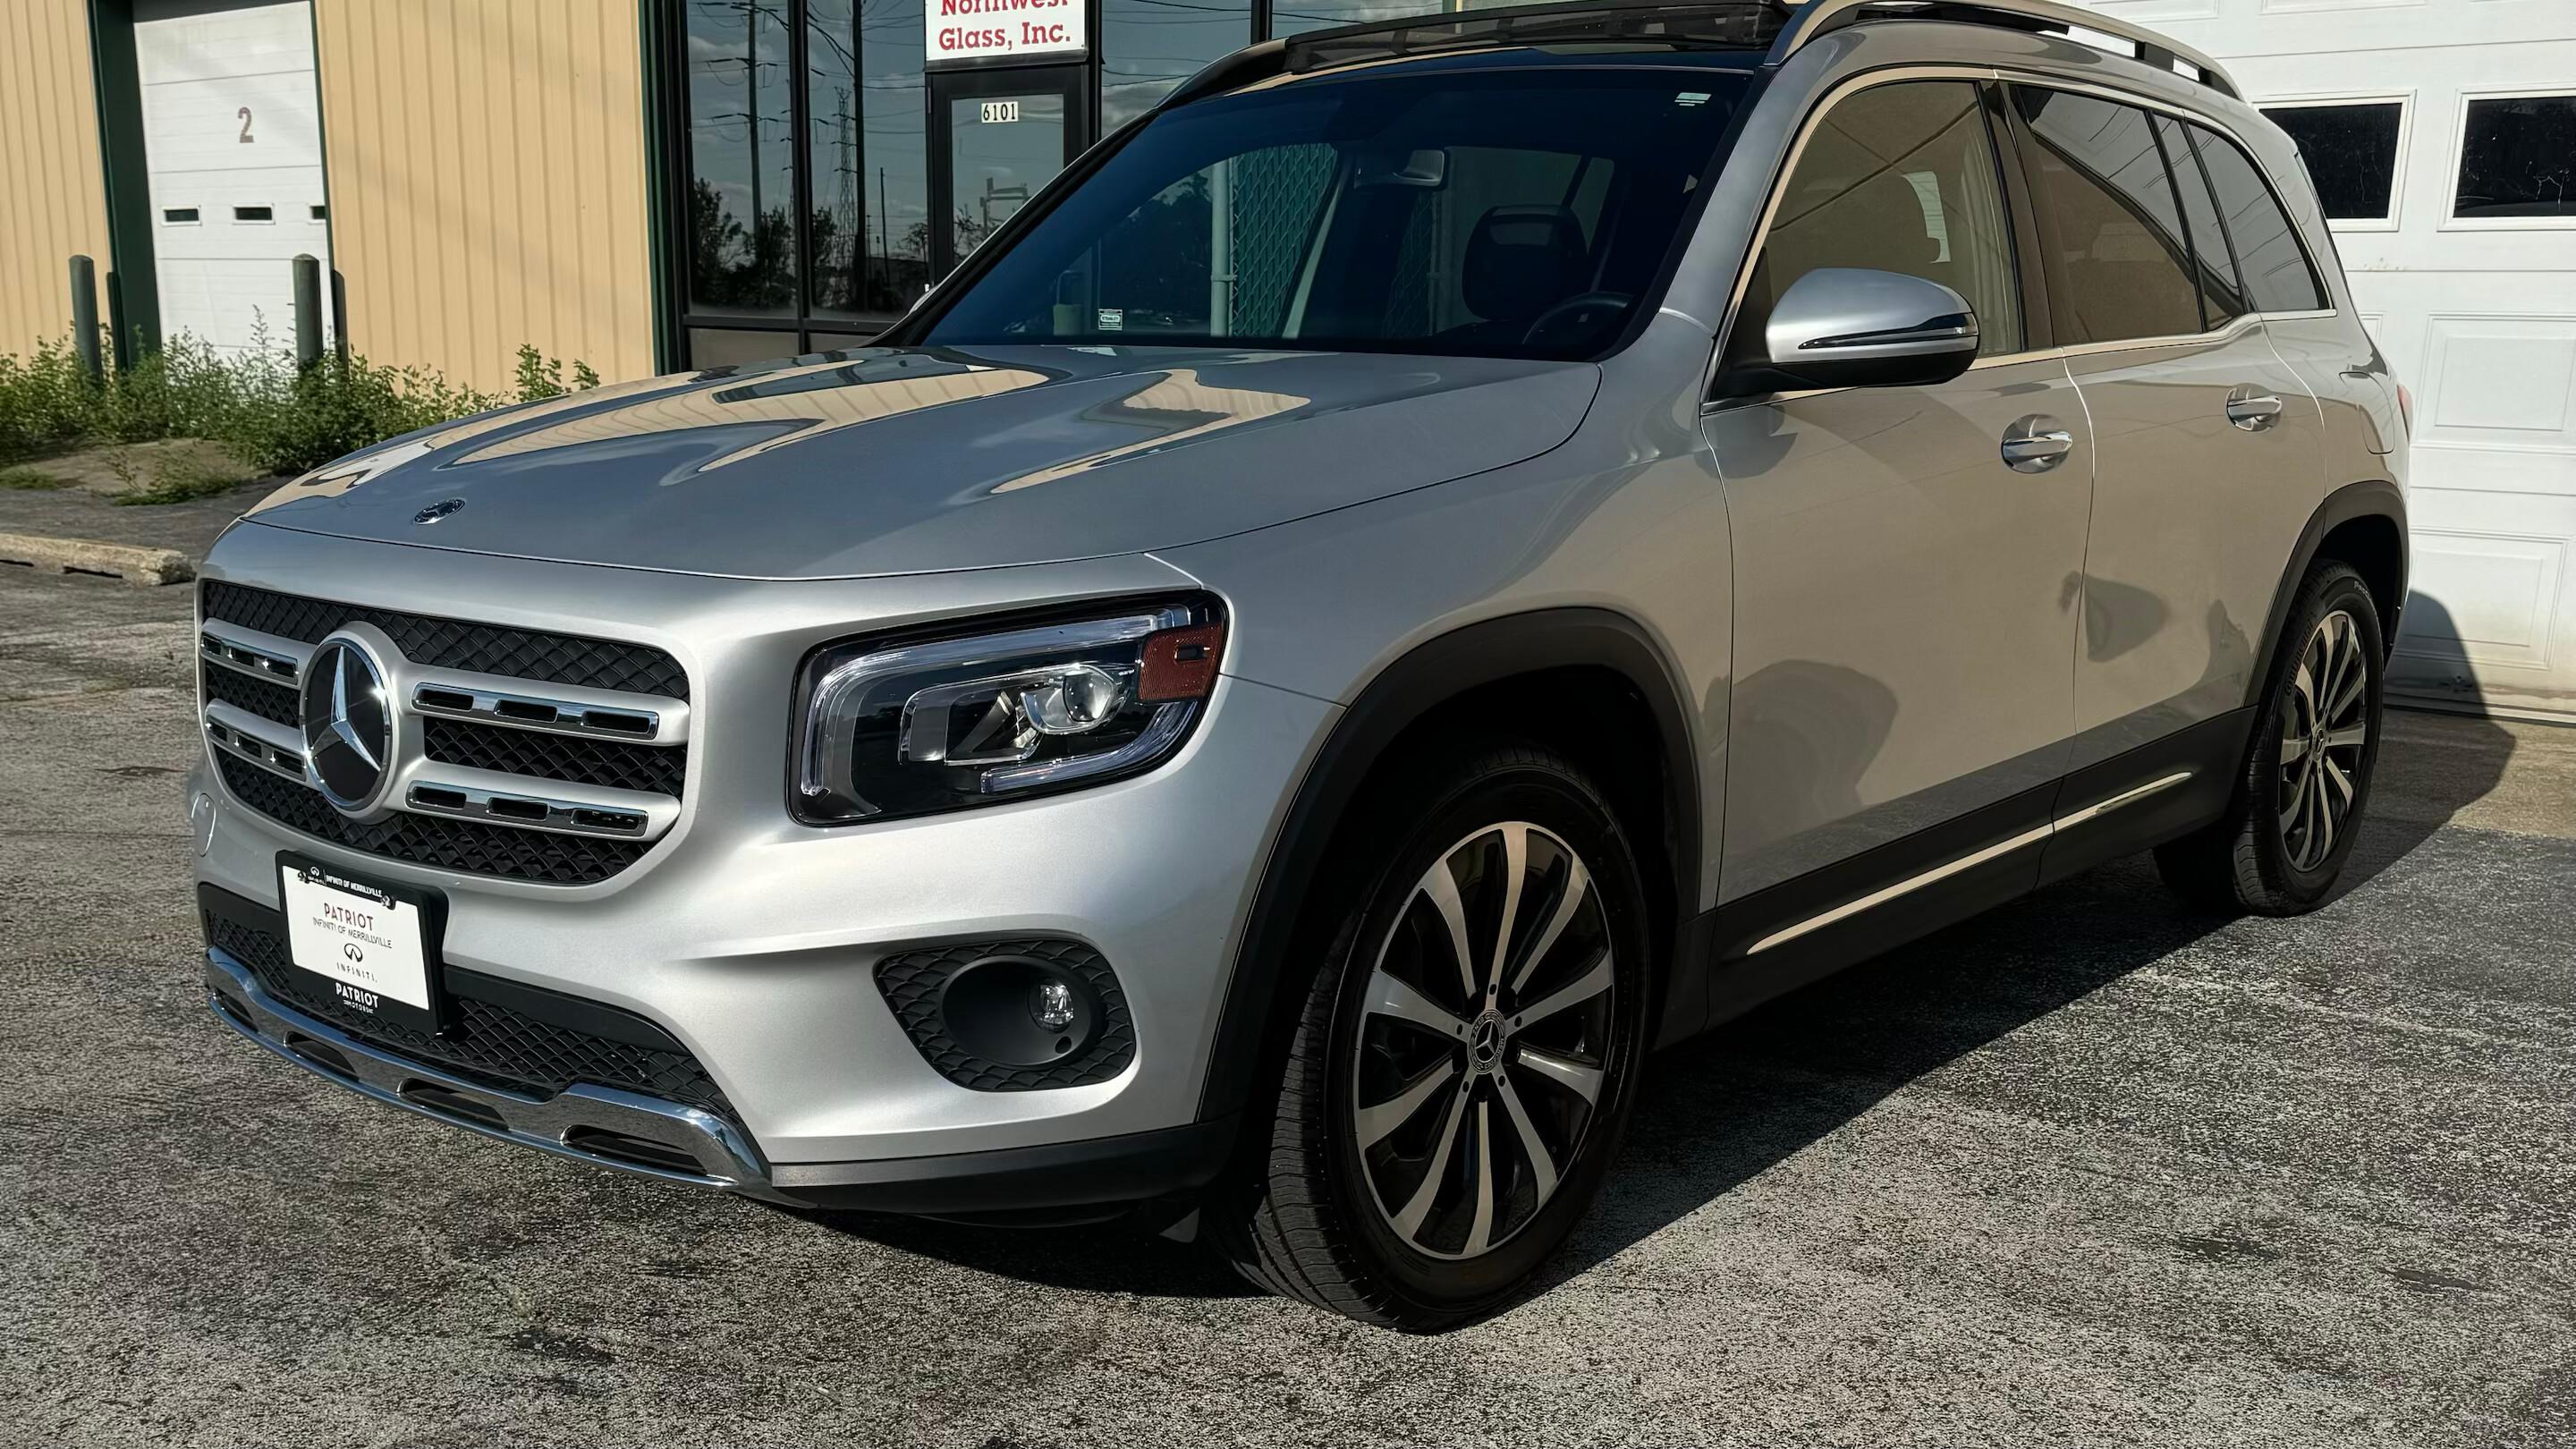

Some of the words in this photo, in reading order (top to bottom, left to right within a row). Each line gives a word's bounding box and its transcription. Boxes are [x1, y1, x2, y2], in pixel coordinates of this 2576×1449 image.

[941, 0, 1068, 16] Northw
[939, 27, 1013, 51] Glass,
[1021, 21, 1071, 45] Inc.
[237, 106, 254, 144] 2
[983, 103, 1016, 122] 6101
[324, 902, 373, 931] PATRIOT
[337, 925, 346, 935] OF
[348, 928, 393, 949] MERRILLVILLE
[335, 982, 378, 1009] PATRIOT
